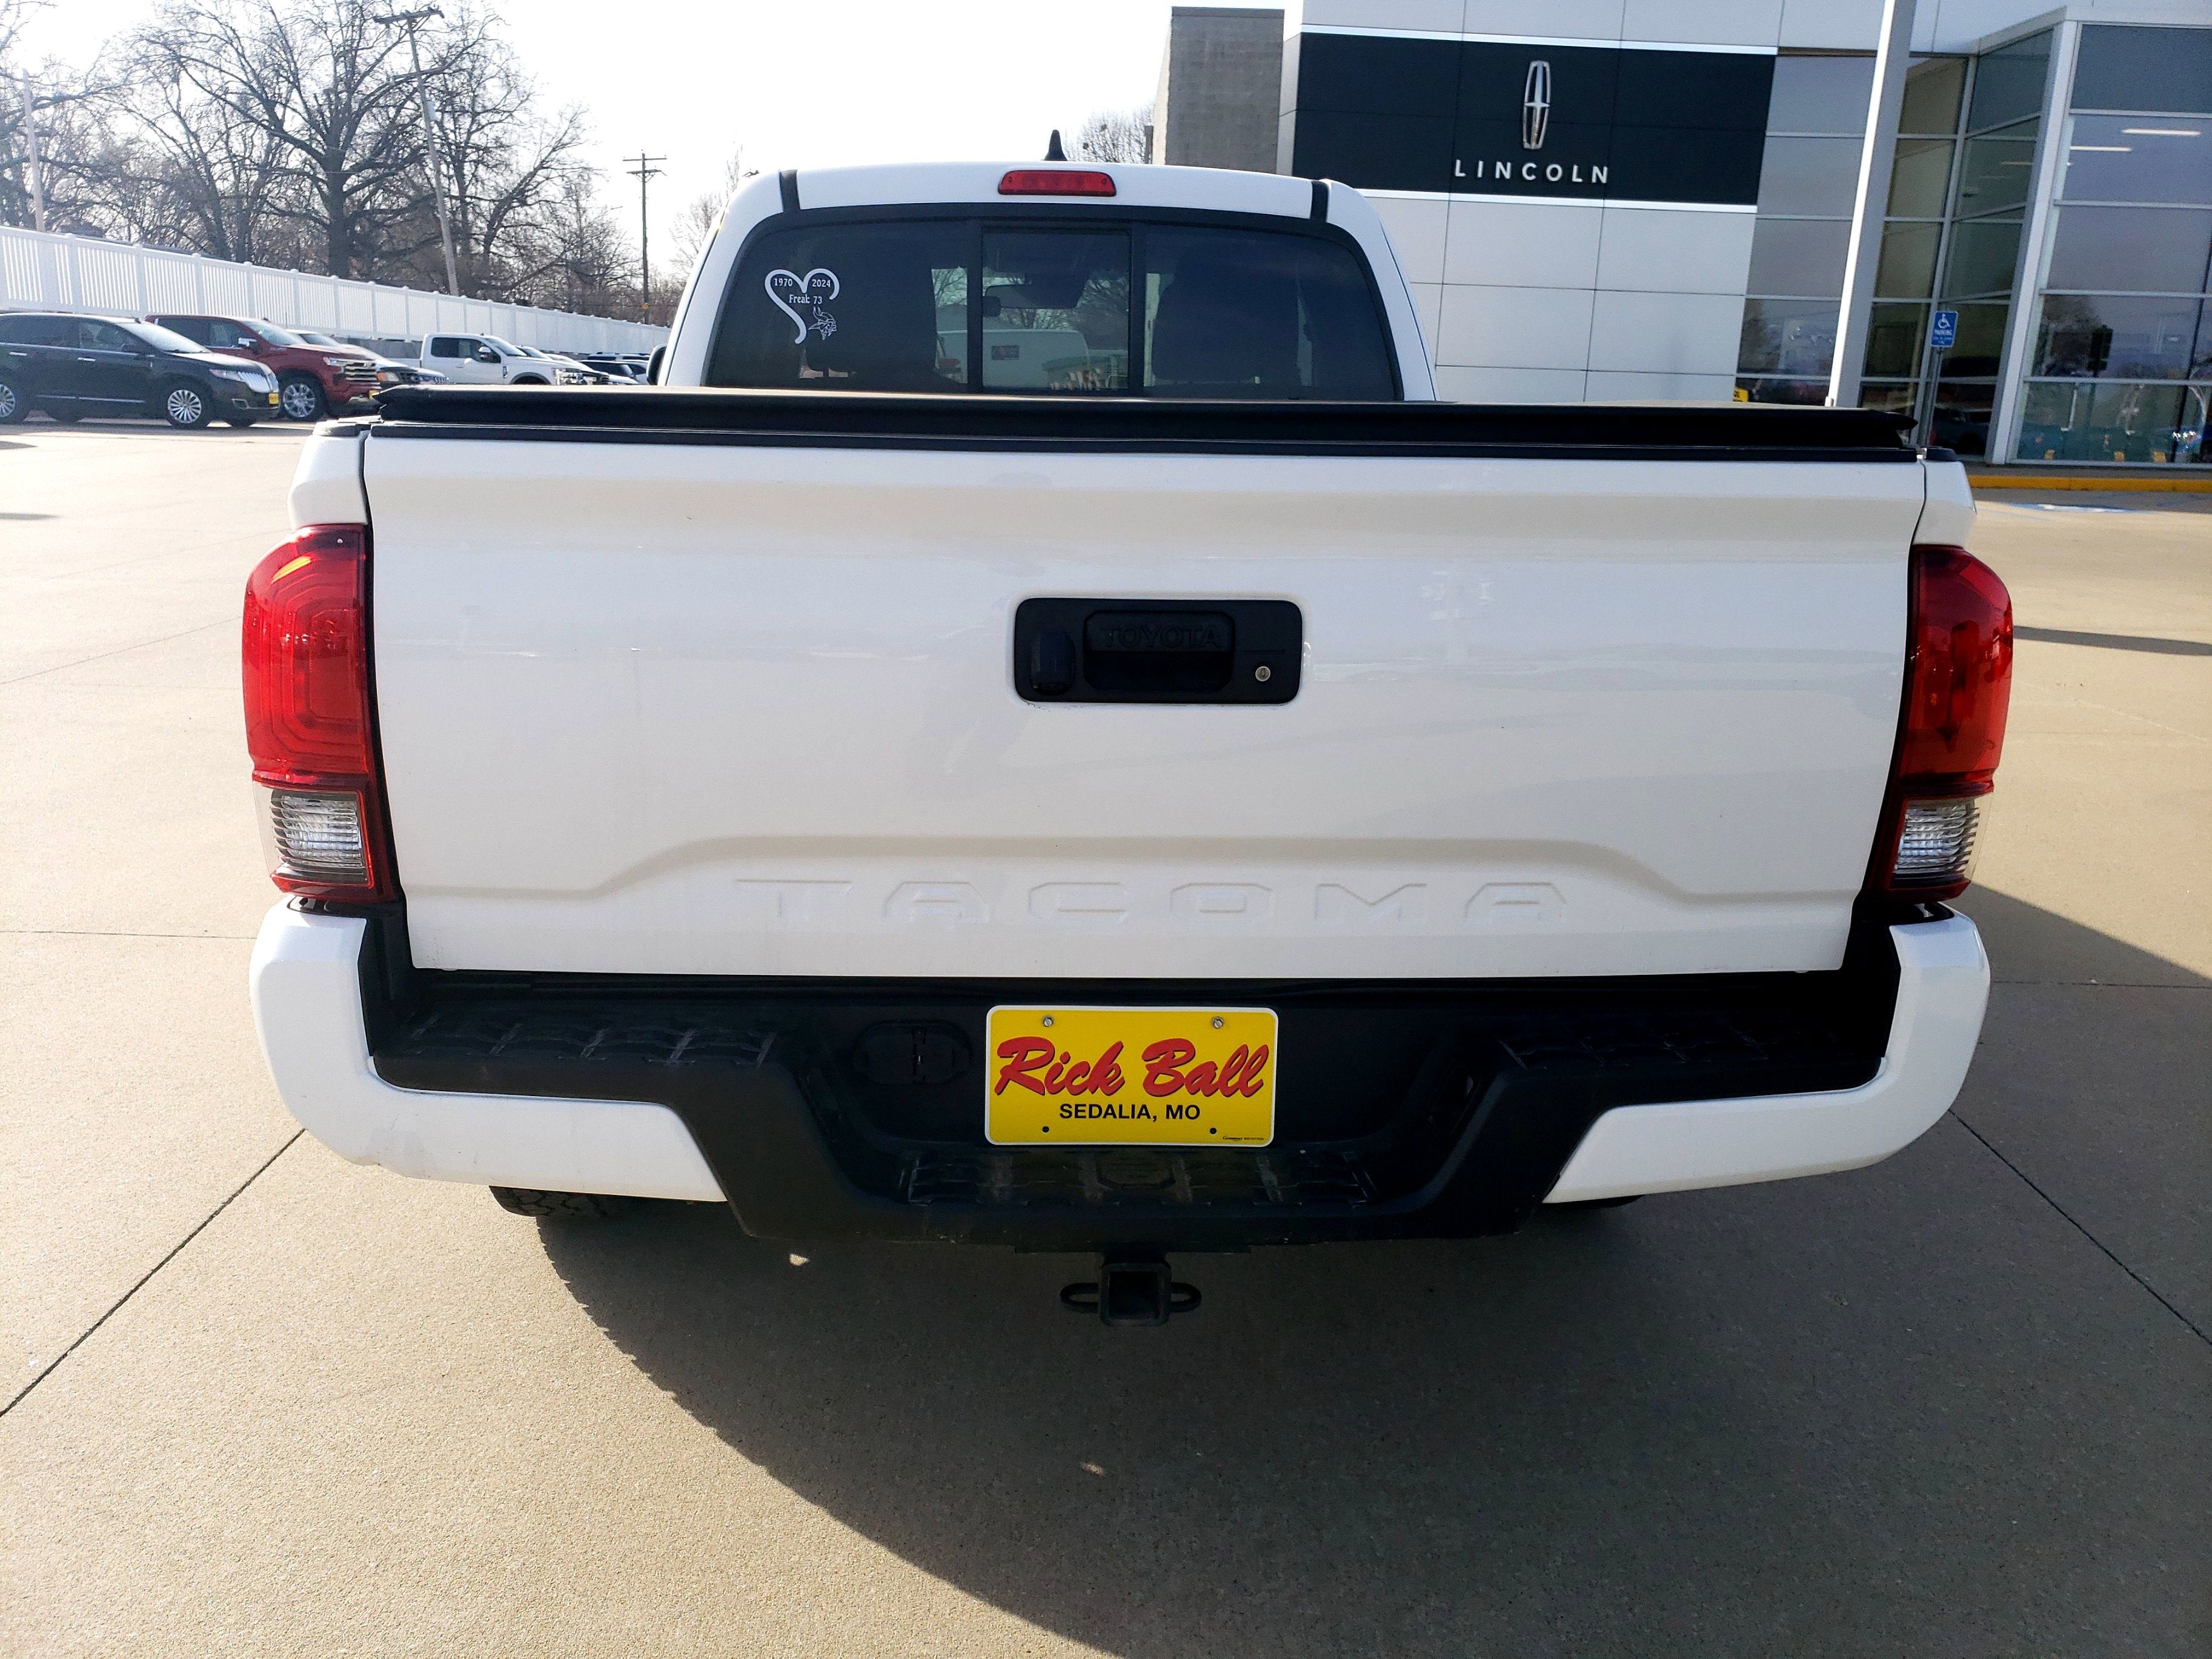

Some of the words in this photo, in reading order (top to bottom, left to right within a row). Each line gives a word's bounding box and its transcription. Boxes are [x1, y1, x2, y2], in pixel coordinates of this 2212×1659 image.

[1455, 159, 1608, 184] LINCOLN
[774, 278, 793, 287] 1970
[789, 294, 810, 304] Freak
[813, 296, 823, 304] 73
[1100, 625, 1222, 648] TOYOTA
[734, 879, 1568, 926] TACOMA
[994, 1036, 1125, 1096] Rick
[1141, 1038, 1269, 1097] Ball
[1060, 1103, 1157, 1122] SEDALIA,
[1165, 1105, 1201, 1120] MO
